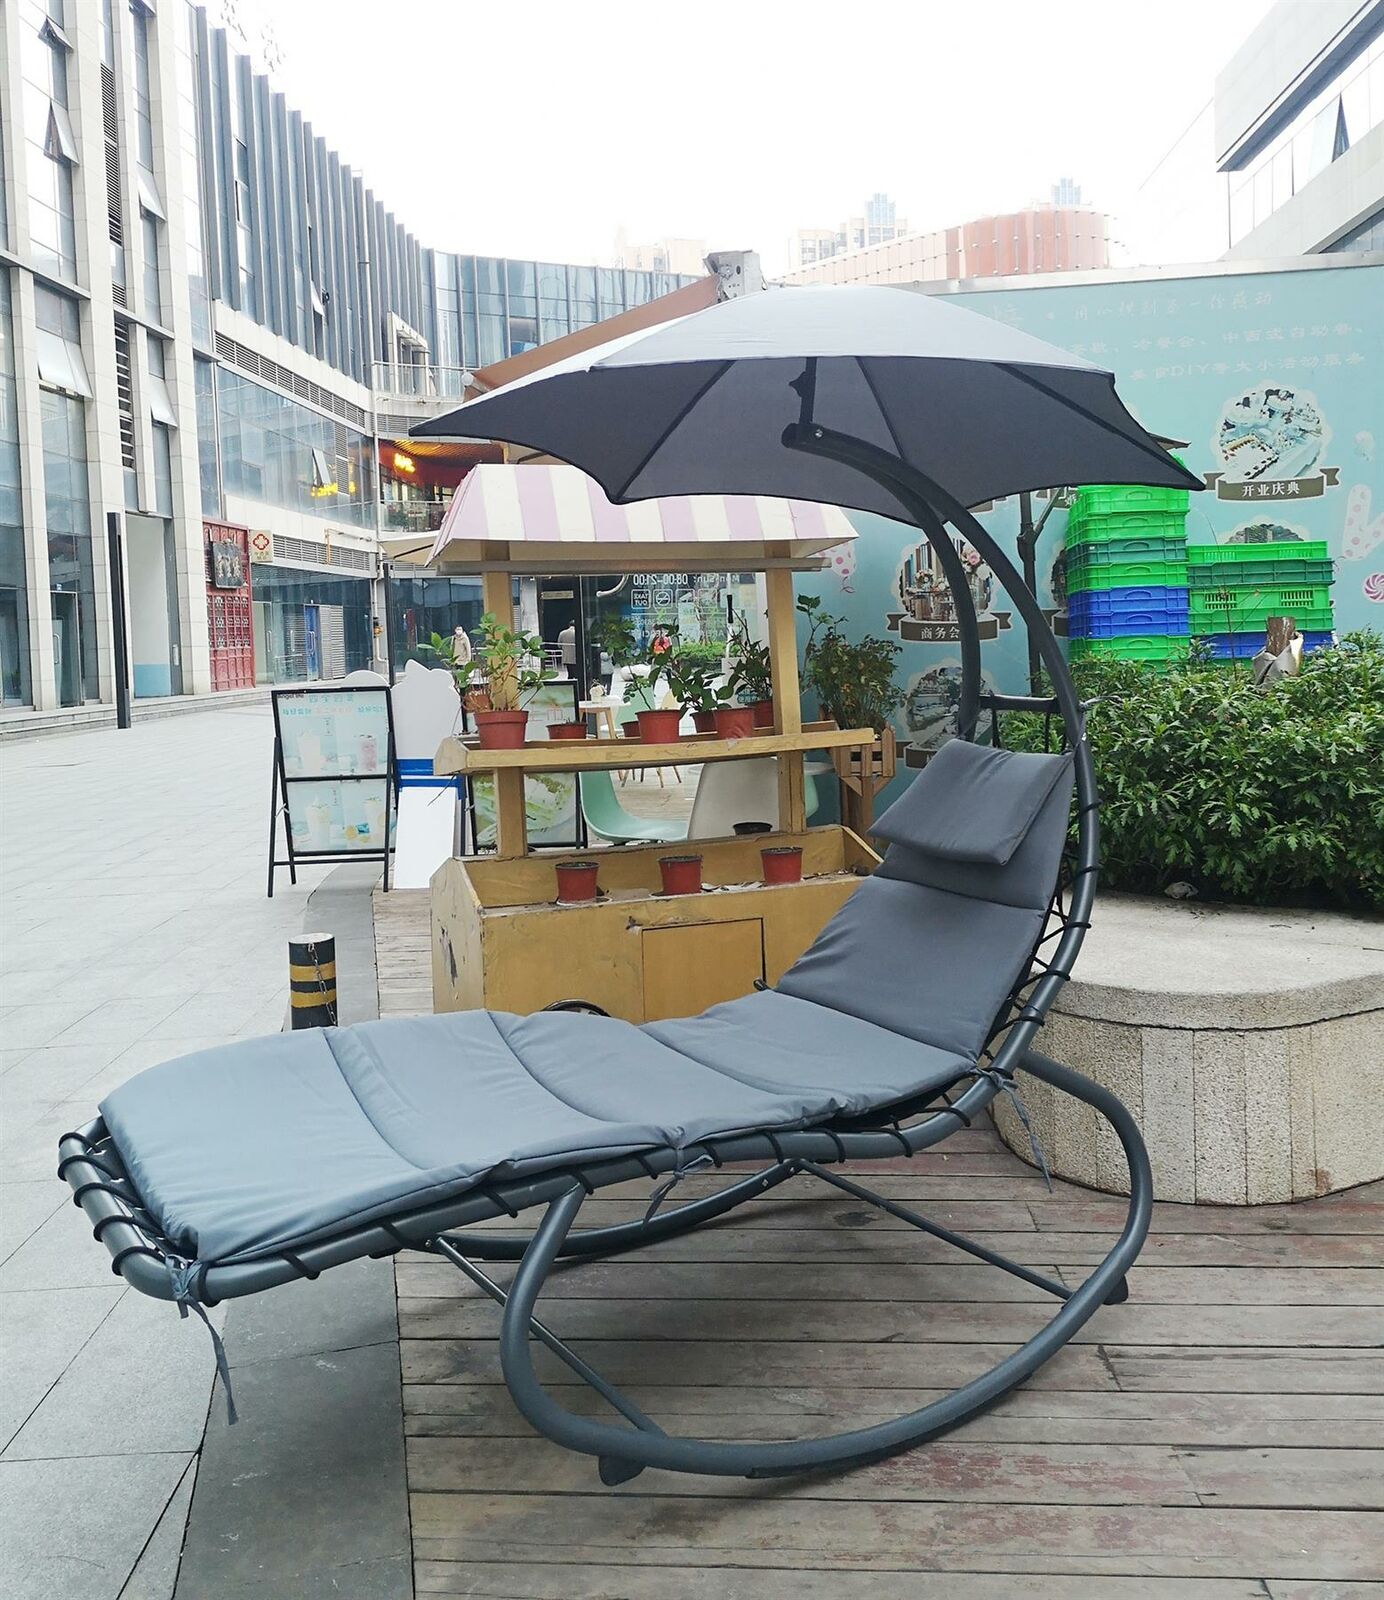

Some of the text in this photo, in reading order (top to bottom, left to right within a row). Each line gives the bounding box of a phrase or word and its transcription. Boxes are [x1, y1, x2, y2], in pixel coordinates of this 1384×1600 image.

[1242, 481, 1300, 497] 开业庆典
[920, 626, 962, 640] 商务会
